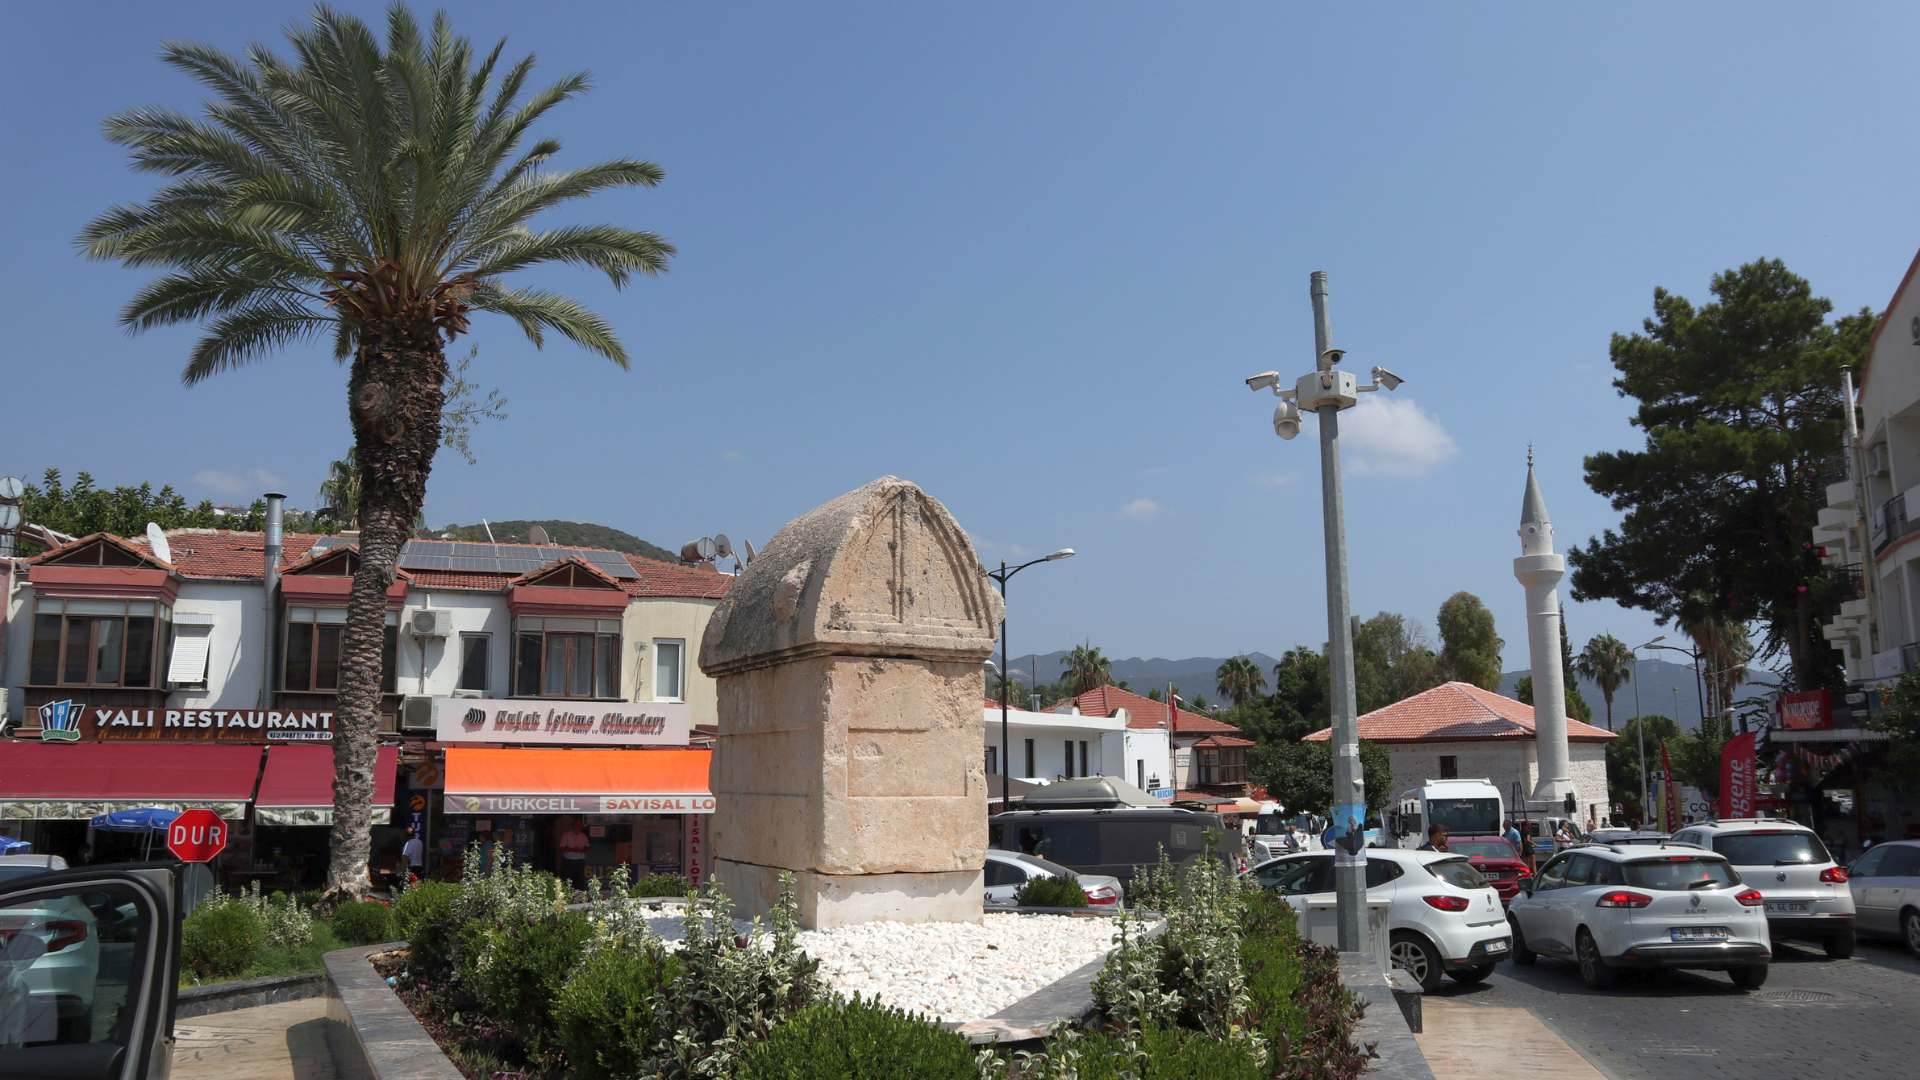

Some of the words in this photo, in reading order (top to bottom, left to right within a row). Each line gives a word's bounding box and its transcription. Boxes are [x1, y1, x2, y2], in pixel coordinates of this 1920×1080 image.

[96, 709, 154, 727] YALI
[165, 710, 333, 729] RESTAURANT
[486, 798, 580, 811] TURKCELL
[606, 799, 686, 811] SAYISAL
[173, 825, 222, 846] DUR
